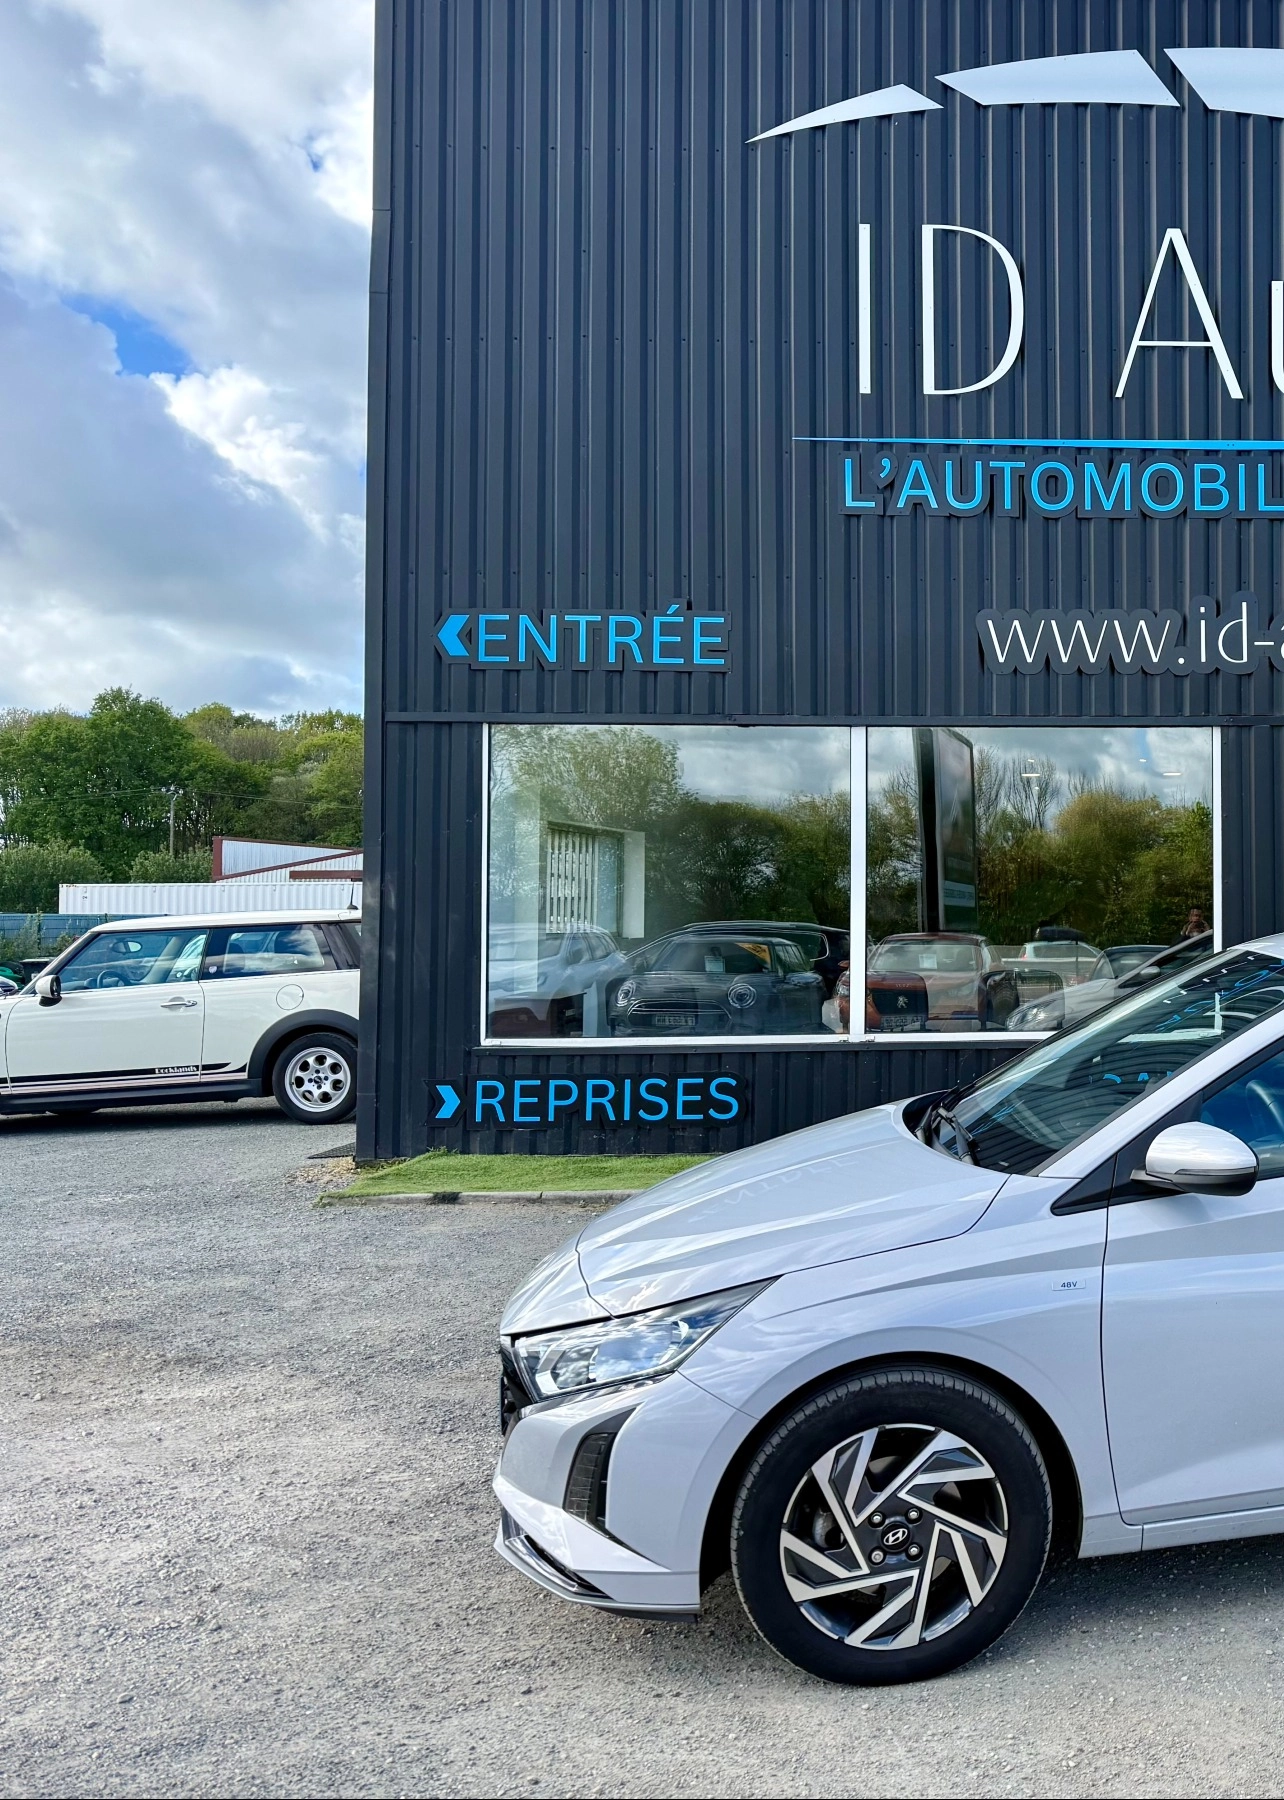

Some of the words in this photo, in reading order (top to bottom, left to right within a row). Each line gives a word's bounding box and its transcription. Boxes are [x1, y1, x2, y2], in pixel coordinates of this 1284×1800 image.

[858, 223, 1024, 395] ID
[477, 603, 725, 665] ENTRÉE
[475, 1076, 739, 1123] REPRISES
[1060, 1281, 1078, 1289] 48V
